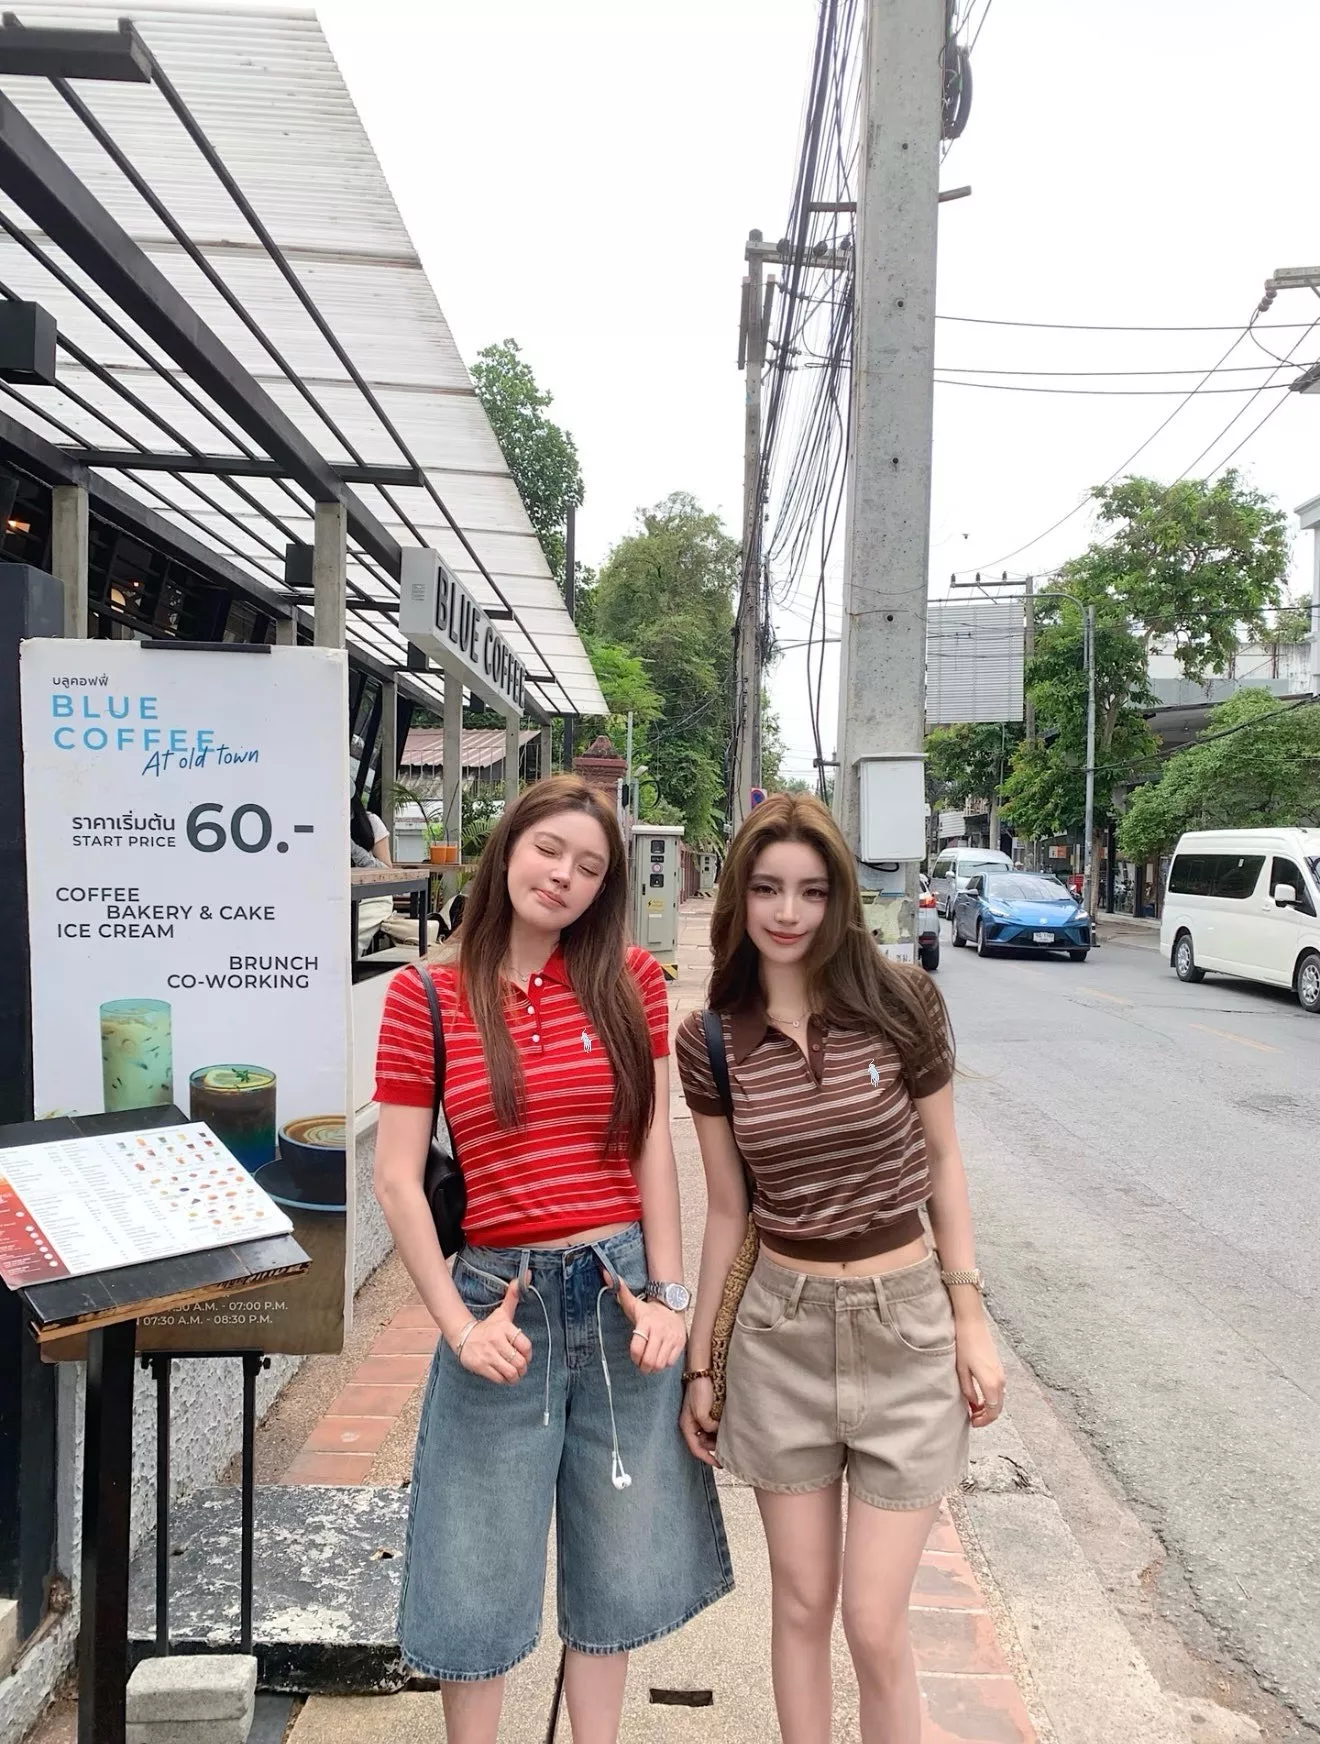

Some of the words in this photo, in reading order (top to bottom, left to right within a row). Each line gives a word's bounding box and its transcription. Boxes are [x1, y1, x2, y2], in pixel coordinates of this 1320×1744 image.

[435, 566, 481, 664] BLUE
[484, 626, 527, 709] COFFEE
[52, 673, 109, 689] บลูคอฟฟี่
[52, 694, 159, 720] BLUE
[53, 726, 216, 753] COFFEE
[141, 750, 175, 777] At
[178, 745, 209, 770] old
[71, 810, 176, 832] ราคาเริ่มต้น
[185, 802, 315, 854] 60.-
[72, 835, 123, 848] START
[128, 836, 177, 848] PRICE
[55, 886, 141, 903] COFFEE
[106, 904, 193, 921] BAKERY
[199, 905, 213, 921] &
[219, 905, 276, 921] CAKE
[57, 923, 92, 939] ICE
[97, 923, 175, 939] CREAM
[229, 955, 319, 971] BRUNCH
[166, 973, 310, 990] CO-WORKING
[192, 1302, 218, 1311] A.M.
[228, 1301, 261, 1311] 07:00
[264, 1301, 289, 1311] P.M.
[143, 1315, 175, 1326] 07:30
[177, 1315, 203, 1325] A.M.
[213, 1315, 246, 1325] 08:30
[248, 1314, 273, 1324] P.M.
